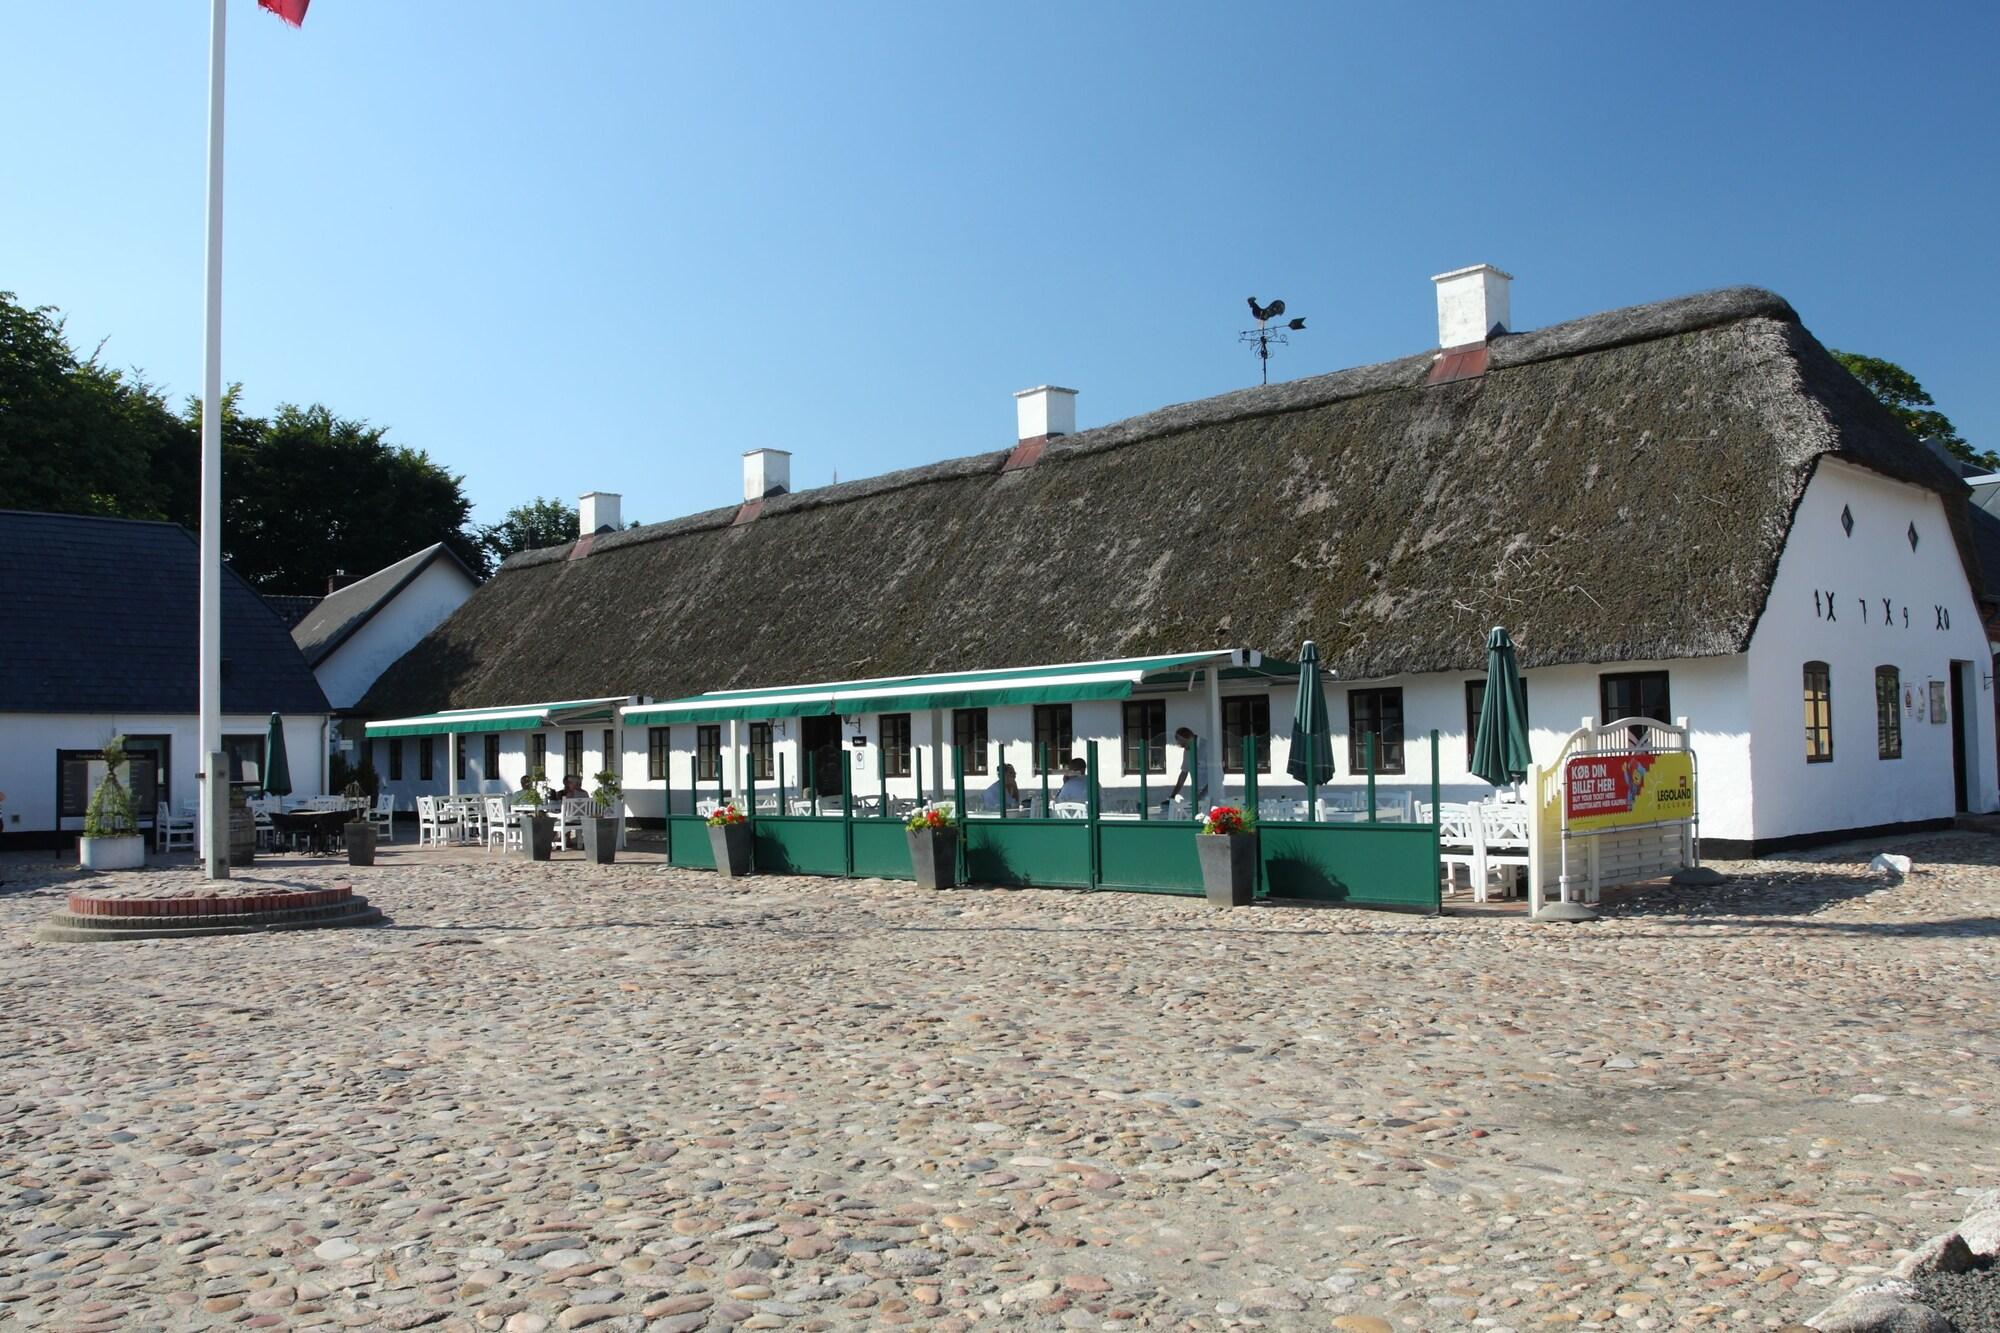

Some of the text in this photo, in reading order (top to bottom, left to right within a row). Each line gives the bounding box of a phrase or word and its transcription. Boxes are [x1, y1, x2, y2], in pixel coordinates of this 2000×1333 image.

[1572, 763, 1607, 780] KØB DIN
[1572, 777, 1616, 795] BILLET HER!
[1657, 788, 1692, 801] LEGOLAND
